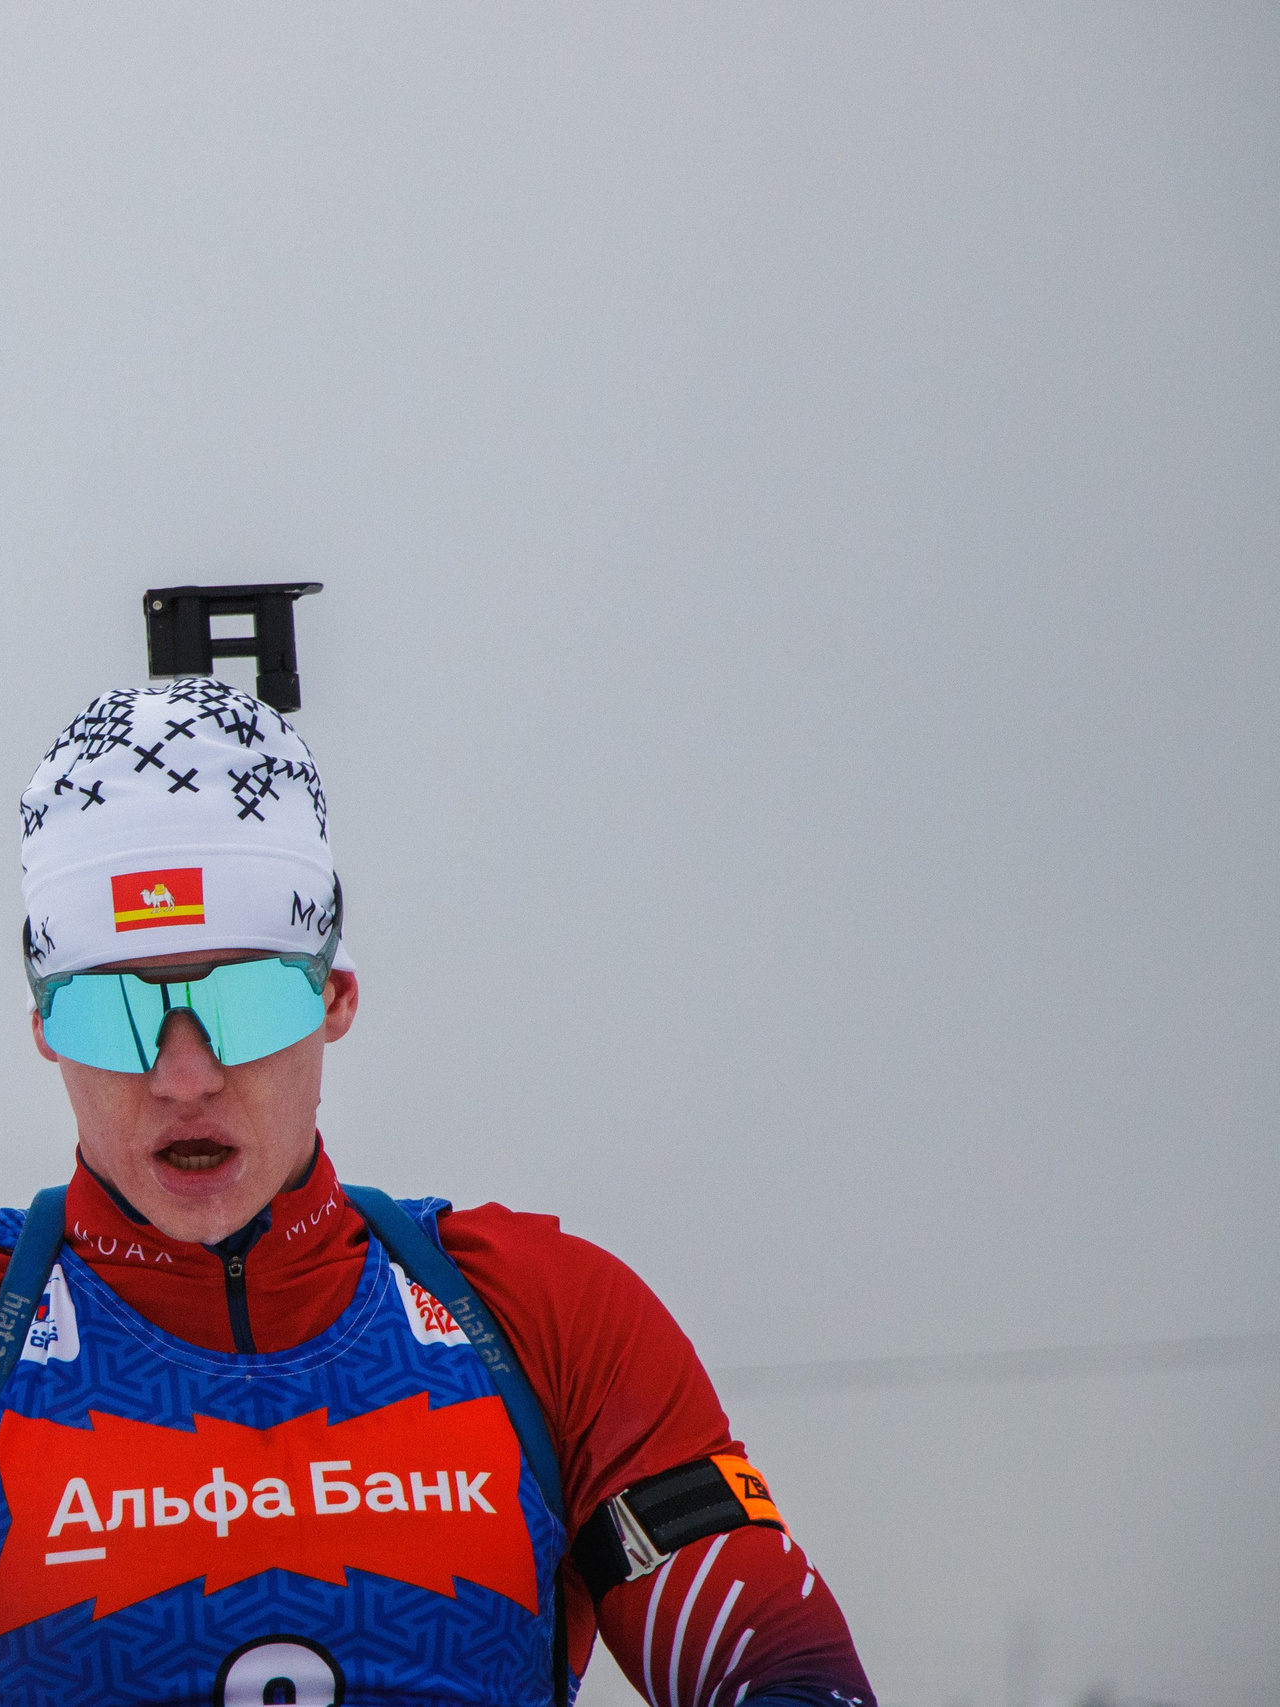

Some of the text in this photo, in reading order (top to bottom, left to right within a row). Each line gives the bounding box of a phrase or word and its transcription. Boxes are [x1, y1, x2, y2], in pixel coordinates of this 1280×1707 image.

[448, 1296, 510, 1373] hiatar
[47, 1460, 497, 1538] Альфа Банк
